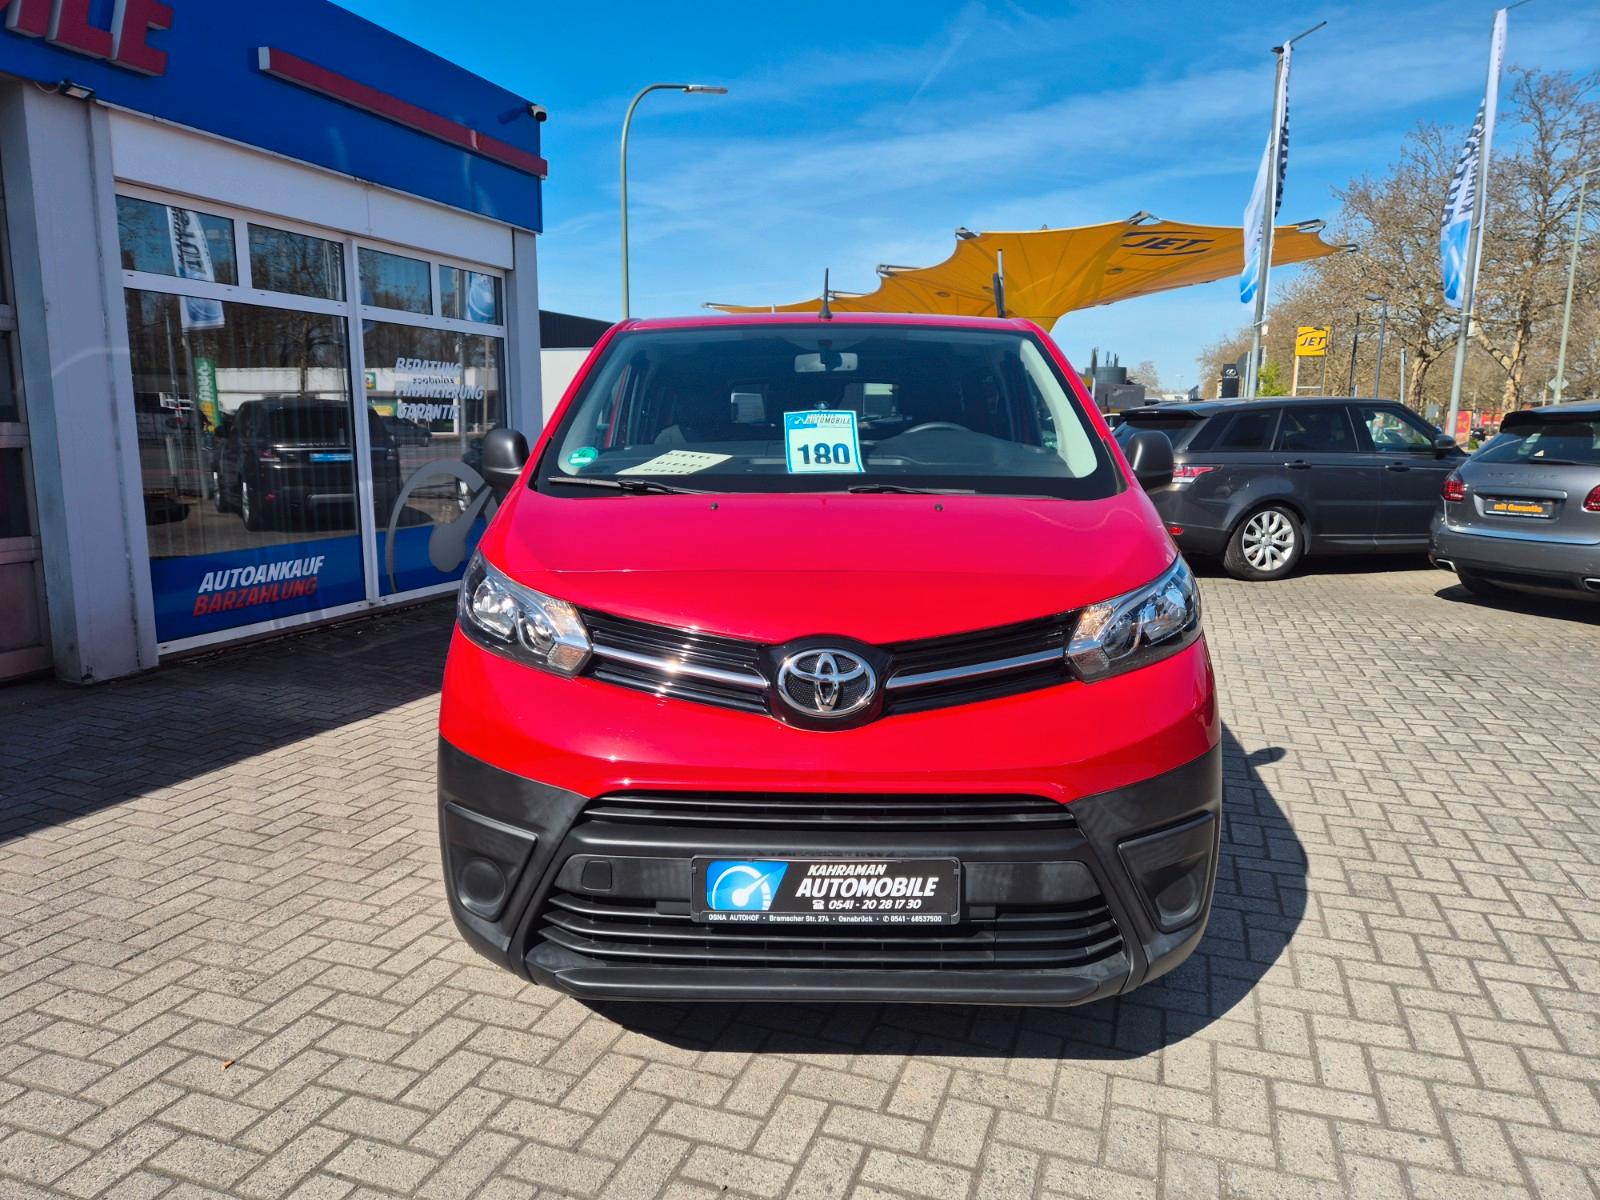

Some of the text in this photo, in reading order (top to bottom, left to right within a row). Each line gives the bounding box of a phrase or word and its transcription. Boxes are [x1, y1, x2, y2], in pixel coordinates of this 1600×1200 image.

[1120, 236, 1215, 250] JET
[1301, 336, 1325, 347] JET
[395, 357, 463, 375] BERATUNG
[397, 402, 461, 421] GARANTIE
[797, 442, 851, 465] 180
[198, 555, 325, 593] AUTOANKAUF
[193, 575, 318, 617] BARZAHLUNG
[807, 864, 887, 876] KAHRAMAN
[795, 877, 939, 897] AUTOMOBILE
[828, 899, 854, 910] 0541
[861, 899, 877, 910] 20
[878, 899, 893, 910] 28
[894, 899, 904, 909] 17
[905, 899, 922, 909] 30
[708, 913, 727, 921] OSNA
[769, 914, 804, 922] Bramscher
[805, 914, 817, 922] Str.
[838, 914, 873, 922] Osnabrück
